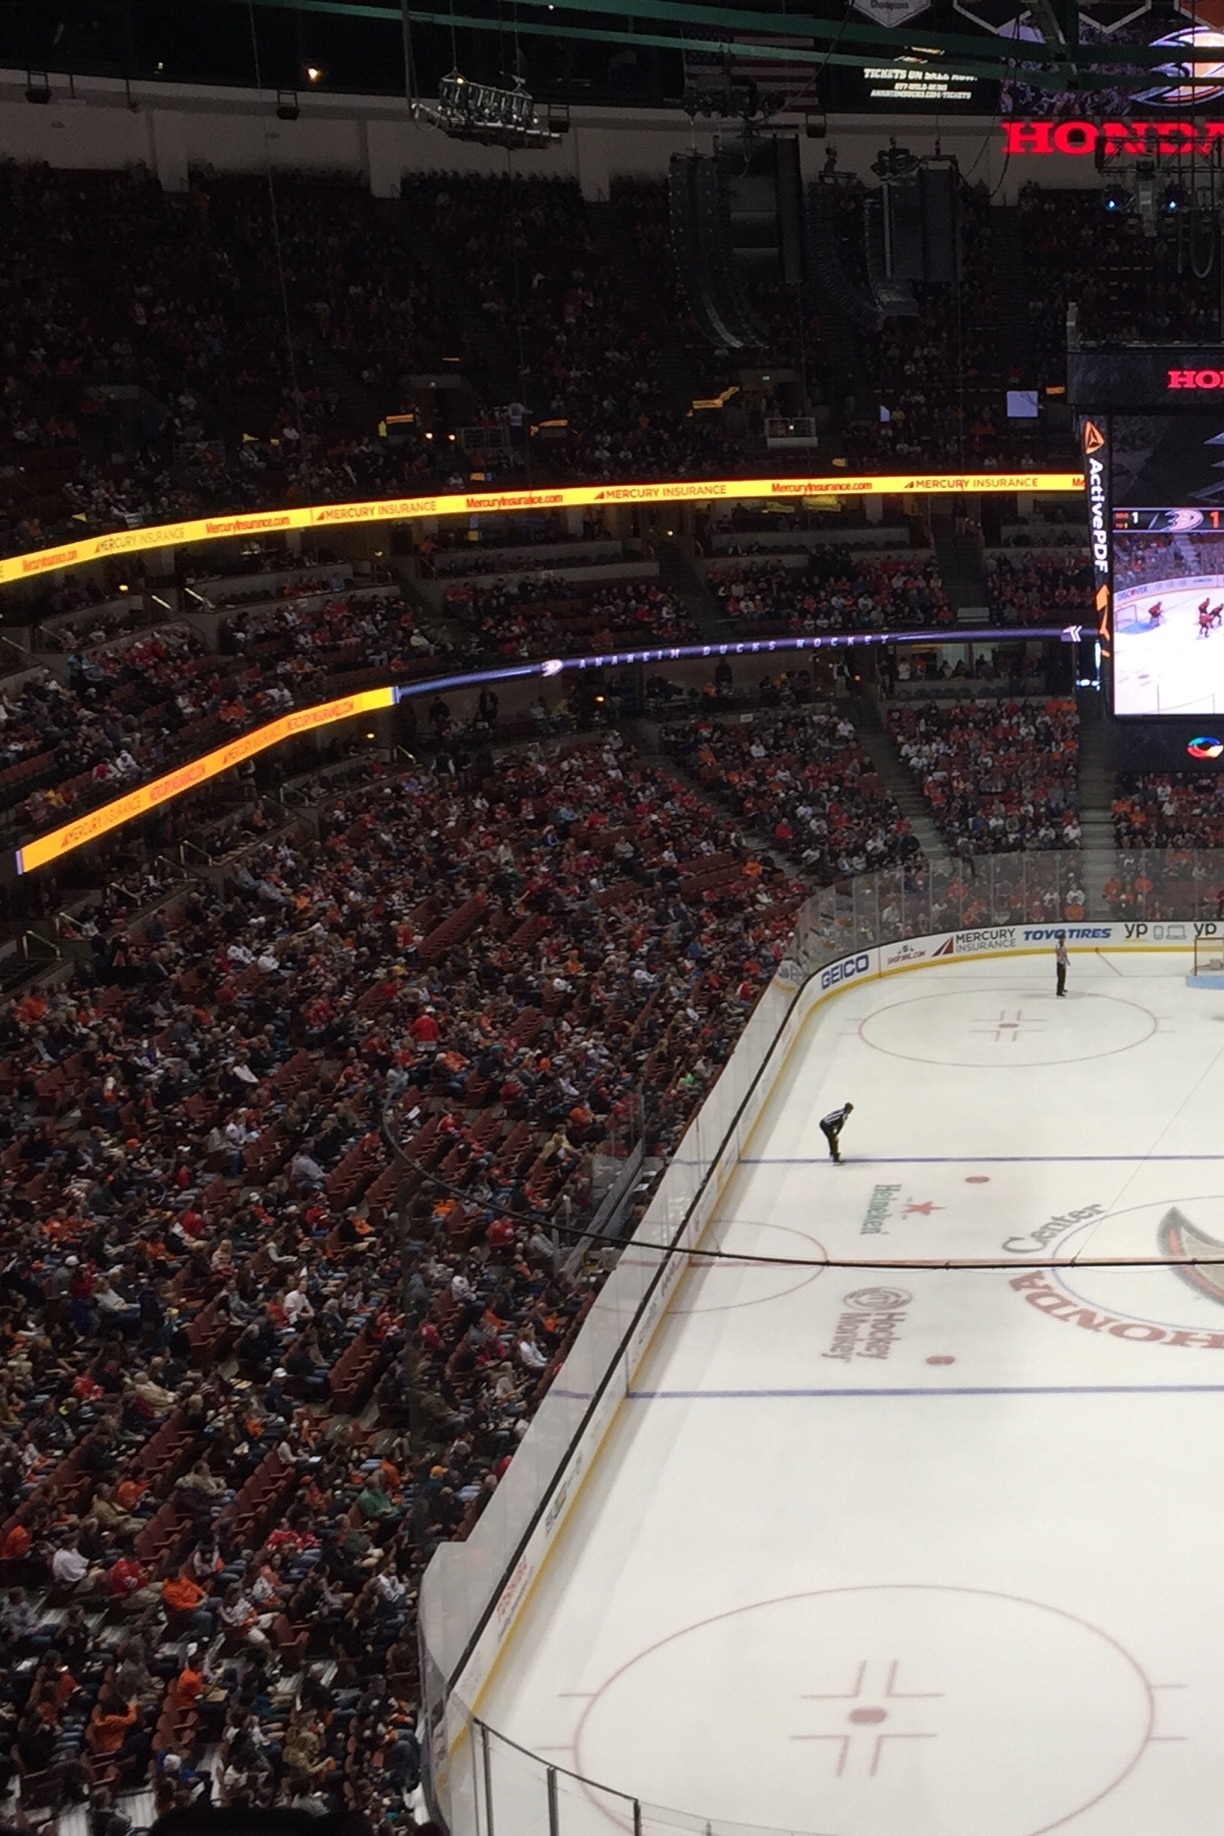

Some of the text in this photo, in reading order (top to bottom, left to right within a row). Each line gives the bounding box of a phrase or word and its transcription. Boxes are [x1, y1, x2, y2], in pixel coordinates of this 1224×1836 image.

[864, 68, 907, 79] TICKETS
[908, 70, 923, 79] ON
[606, 485, 726, 499] MERCURY INSURANCE
[916, 478, 1039, 489] MERCURY INSURANCE
[326, 502, 437, 520] MERCURY INSURANCE
[1089, 458, 1108, 573] ActivePDF
[1132, 512, 1138, 524] 1
[1210, 511, 1219, 528] 1
[703, 641, 776, 656] DUCKS
[797, 635, 889, 648] HOCKEY
[956, 928, 1016, 945] MERCURY
[1024, 927, 1112, 941] TOYO TIRES
[1125, 923, 1148, 939] yp
[1194, 923, 1217, 937] yp
[957, 939, 1016, 953] INSURANCE
[821, 954, 869, 990] GEICO
[860, 1184, 901, 1235] Heineken
[1002, 1203, 1104, 1253] Center
[821, 1313, 872, 1360] Monkey
[856, 1312, 907, 1360] Hockey
